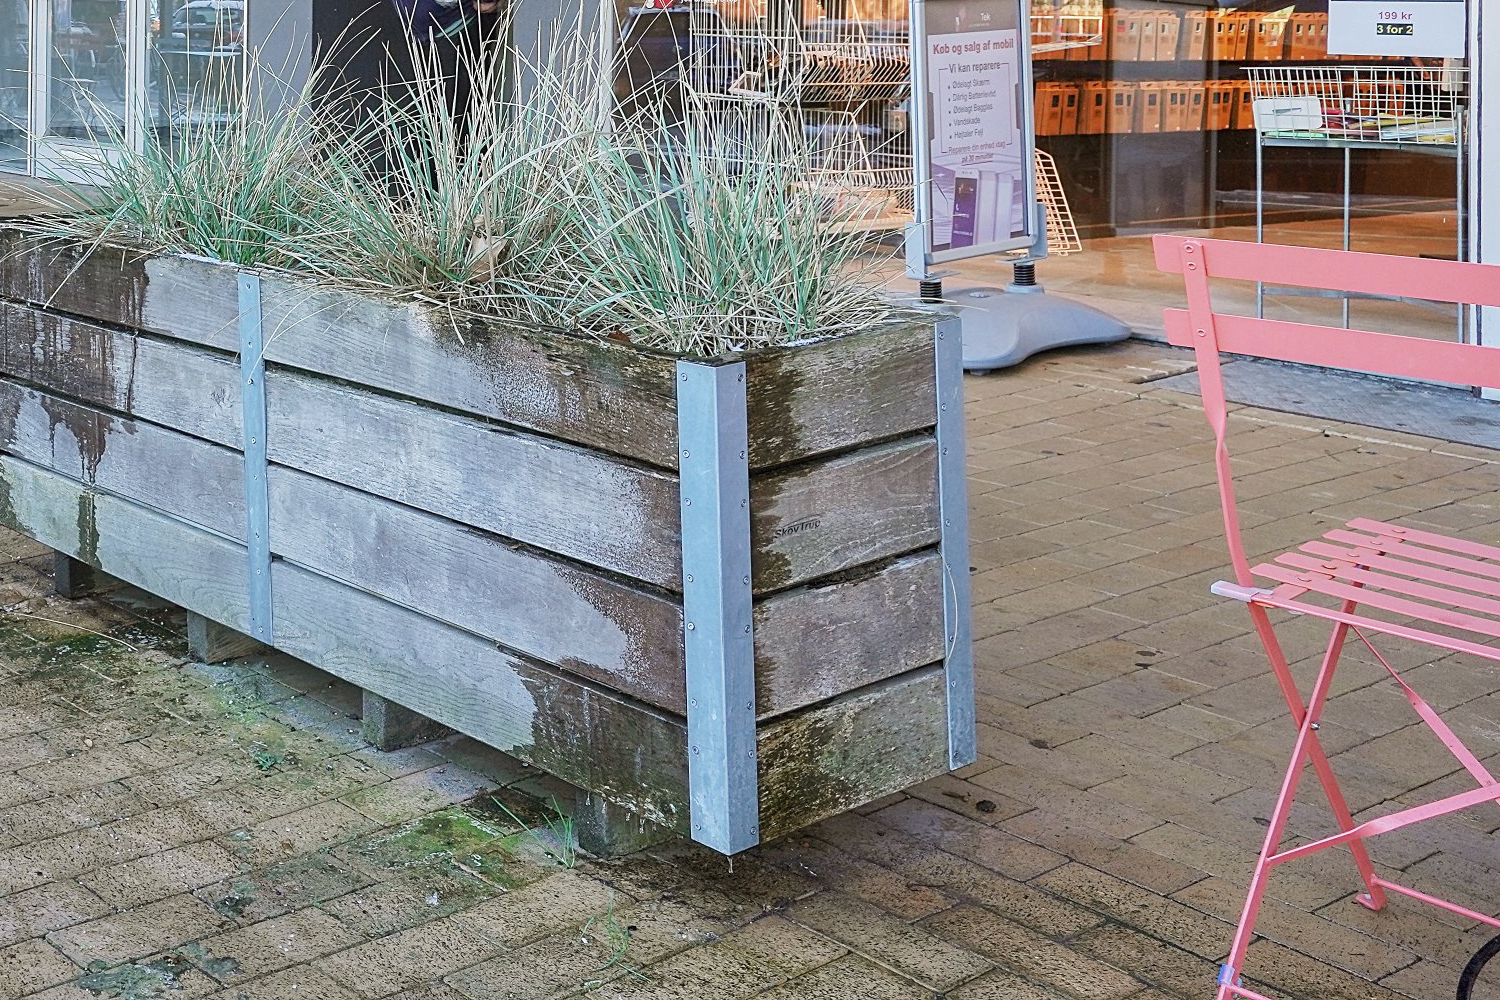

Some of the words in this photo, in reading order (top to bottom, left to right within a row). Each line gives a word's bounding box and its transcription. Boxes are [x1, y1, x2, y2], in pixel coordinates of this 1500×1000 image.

[1378, 12, 1397, 20] 199
[1401, 12, 1413, 20] kr
[1377, 25, 1384, 34] 3
[1386, 24, 1403, 34] for
[1406, 25, 1413, 34] 2
[933, 43, 949, 54] Køb
[952, 46, 962, 55] og
[964, 41, 980, 53] salg
[983, 40, 991, 50] af
[992, 38, 1014, 49] mobil
[949, 63, 956, 73] Vi
[958, 63, 971, 72] kan
[972, 61, 1000, 73] reparere
